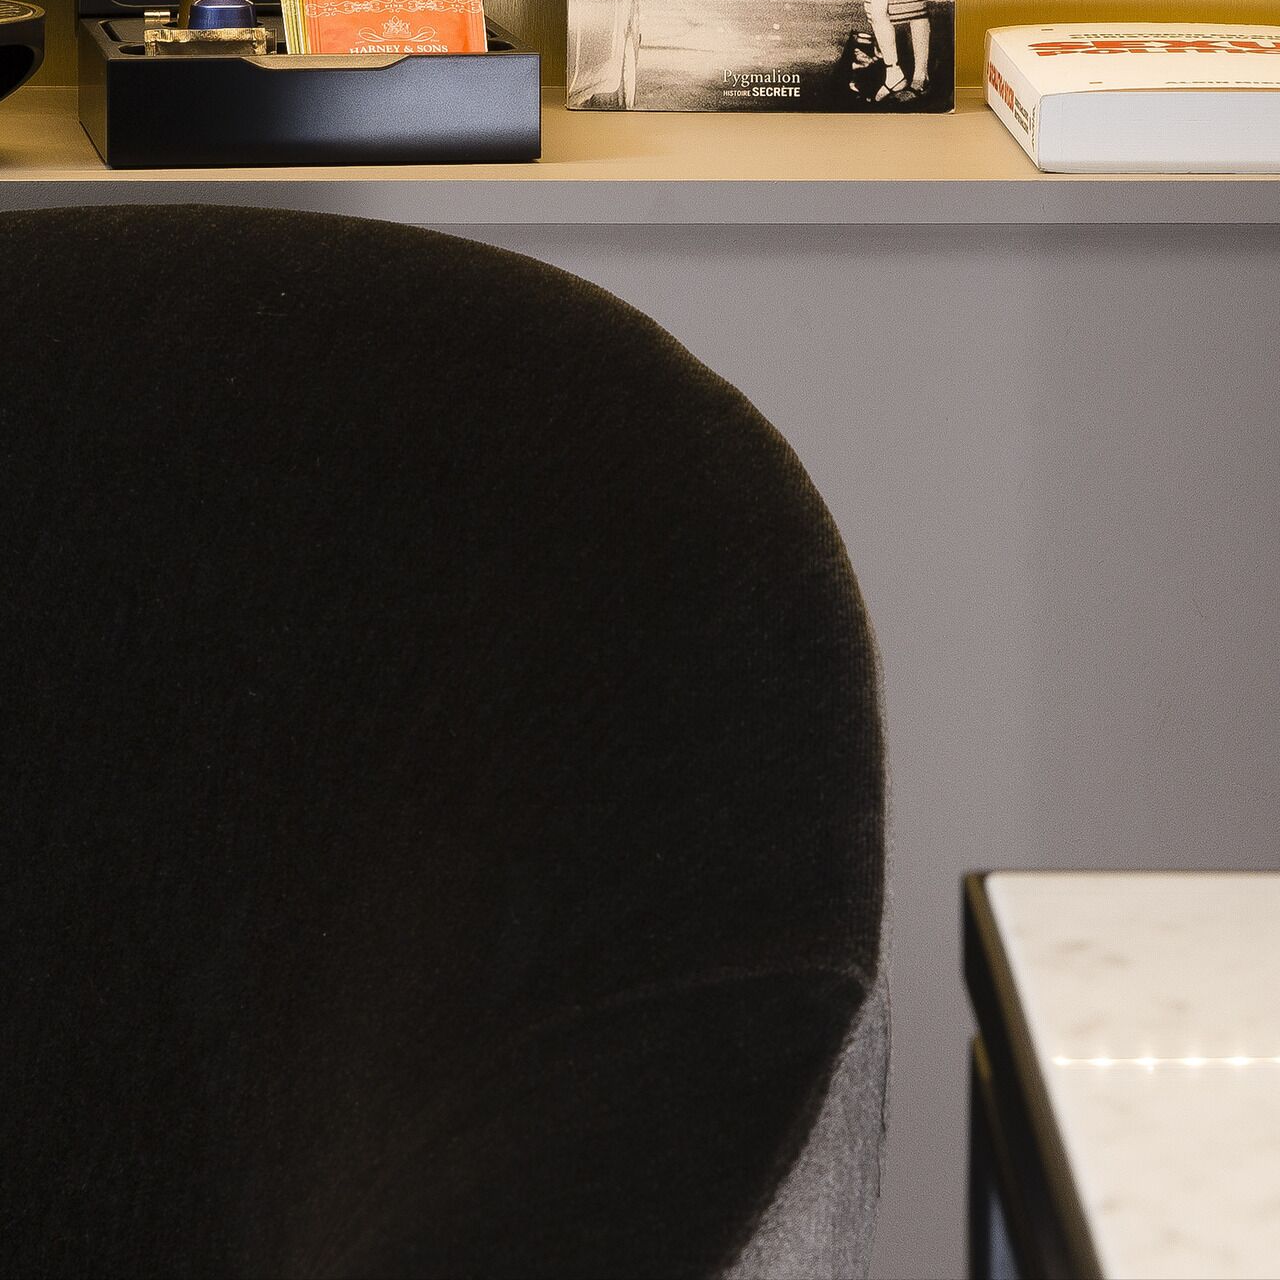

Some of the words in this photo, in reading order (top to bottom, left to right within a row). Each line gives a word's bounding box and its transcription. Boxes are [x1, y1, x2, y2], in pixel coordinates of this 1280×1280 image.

[350, 45, 400, 54] HARNEY
[404, 45, 414, 53] &
[417, 45, 448, 53] SONS
[723, 69, 800, 87] Pygmalion
[752, 86, 801, 97] SECRÈTE
